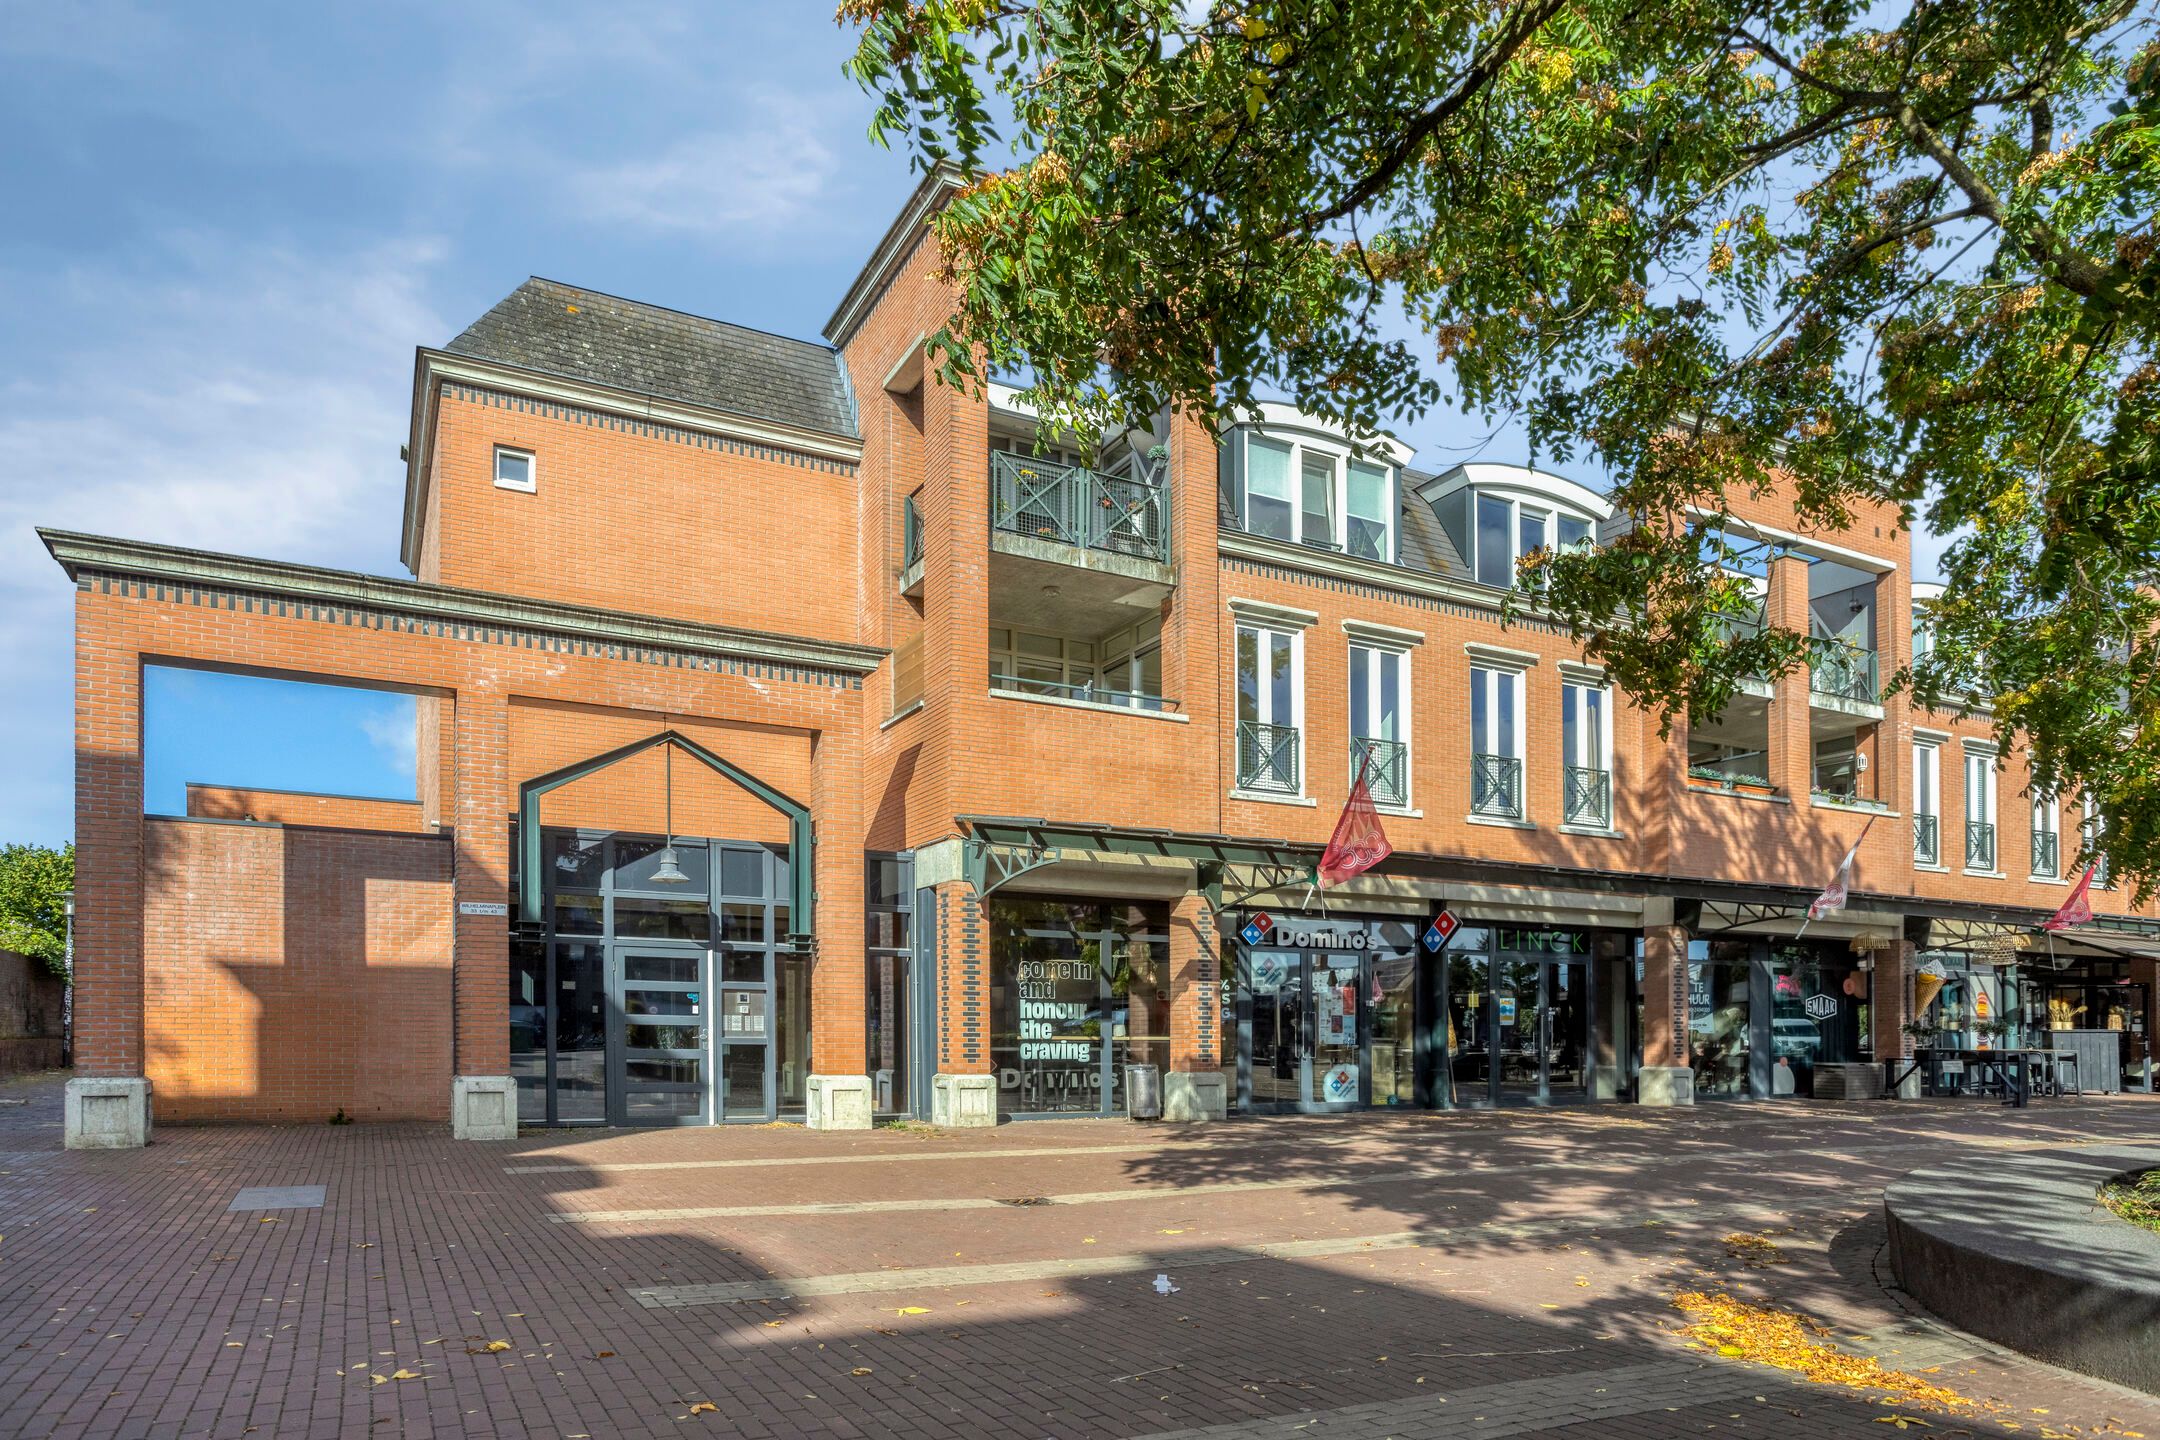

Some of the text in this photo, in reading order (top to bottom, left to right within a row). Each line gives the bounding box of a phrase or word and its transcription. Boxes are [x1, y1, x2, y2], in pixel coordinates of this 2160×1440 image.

[1277, 926, 1379, 950] Domino's
[1500, 929, 1584, 953] LINCK
[1019, 960, 1092, 980] come in
[1019, 980, 1056, 999] and
[1694, 982, 1704, 993] TE
[1020, 999, 1087, 1019] honour
[1807, 997, 1835, 1016] SMAAK
[1020, 1020, 1053, 1039] the
[1020, 1040, 1090, 1062] craving
